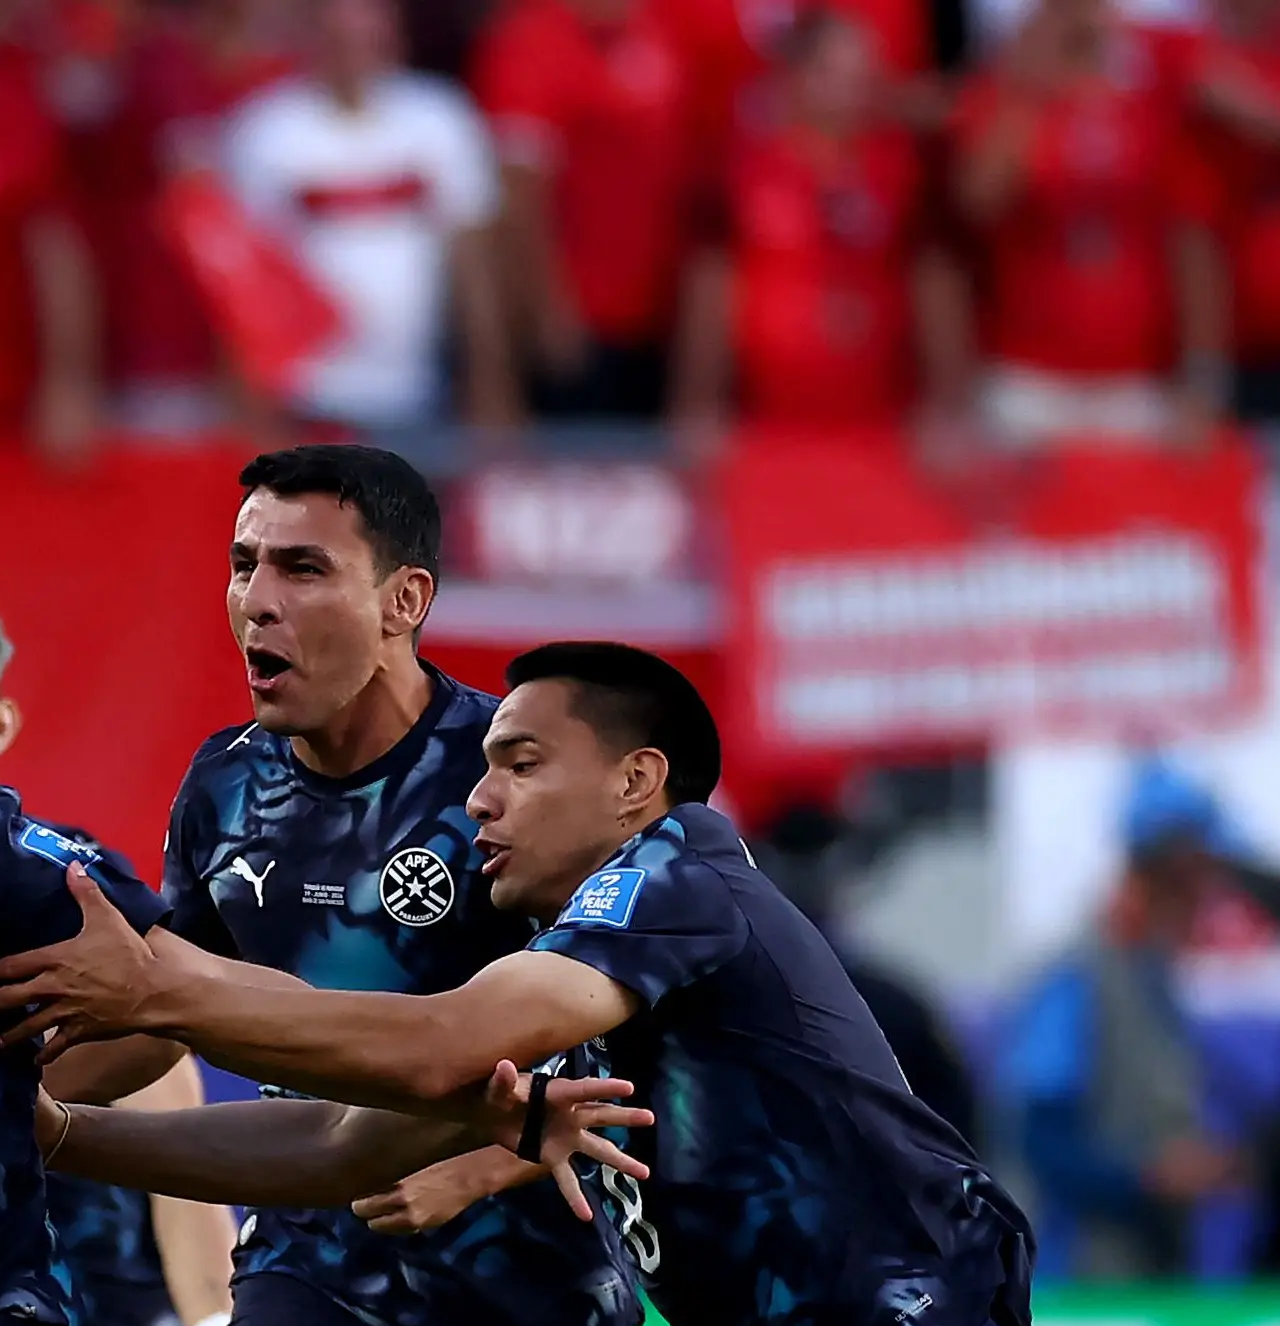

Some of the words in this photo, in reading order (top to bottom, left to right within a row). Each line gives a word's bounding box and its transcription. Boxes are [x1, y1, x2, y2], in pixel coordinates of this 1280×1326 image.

[405, 854, 429, 868] APF
[580, 896, 616, 911] PEACE
[398, 910, 434, 922] PARAGUAY
[601, 1163, 660, 1273] 8
